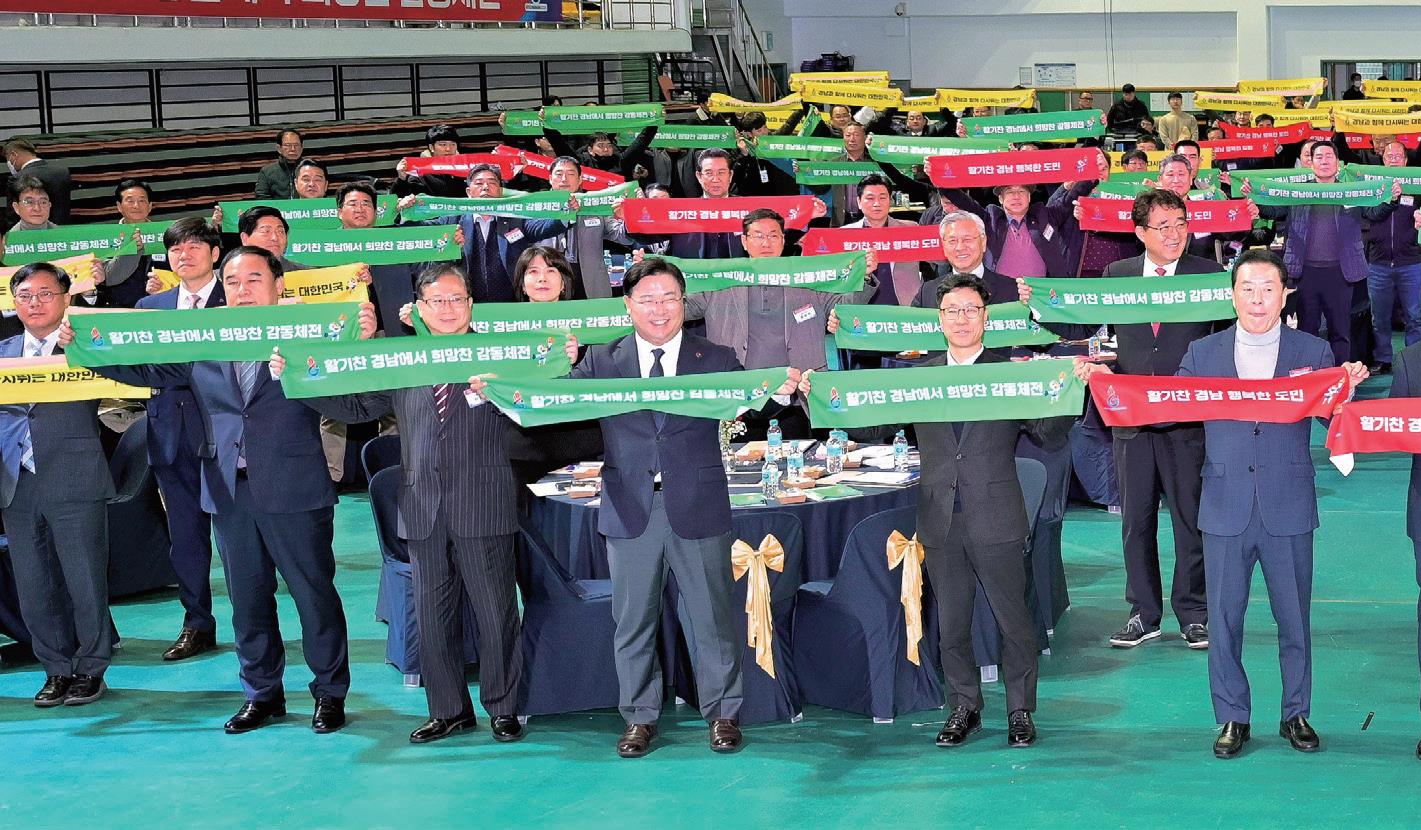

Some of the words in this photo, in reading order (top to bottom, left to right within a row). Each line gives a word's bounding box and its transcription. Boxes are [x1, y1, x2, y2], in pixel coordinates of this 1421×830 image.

[968, 166, 995, 175] 활기찬
[996, 165, 1014, 174] 경남
[1016, 163, 1042, 173] 행복한
[1043, 162, 1061, 172] 도민
[668, 210, 697, 220] 활기찬
[700, 210, 719, 219] 경남
[1194, 211, 1212, 220] 도민
[38, 241, 67, 252] 희망찬
[70, 239, 109, 250] 감동체전
[292, 243, 321, 253] 활기찬
[324, 242, 362, 252] 경남에서
[366, 241, 394, 251] 희망찬
[397, 240, 433, 251] 감동체전
[843, 241, 871, 251] 활기찬
[873, 240, 891, 250] 경남
[893, 239, 920, 249] 행복한
[922, 238, 940, 249] 도민
[299, 282, 344, 297] 대한민국
[1064, 293, 1098, 305] 활기찬
[1100, 292, 1148, 305] 경남에서
[1151, 291, 1186, 304] 희망찬
[866, 321, 898, 333] 활기찬
[108, 331, 153, 345] 활기찬
[157, 328, 215, 342] 경남에서
[220, 326, 262, 341] 희망찬
[266, 324, 322, 339] 감동체전
[324, 356, 367, 372] 활기찬
[371, 352, 427, 369] 경남에서
[432, 349, 473, 365] 희망찬
[477, 345, 531, 361] 감동체전
[846, 392, 886, 406] 활기찬
[890, 388, 944, 403] 경남에서
[948, 384, 987, 399] 희망찬
[991, 381, 1044, 396] 감동체전
[1147, 389, 1191, 403] 활기찬
[1194, 389, 1224, 401] 경남
[1228, 389, 1271, 401] 행복한
[1275, 389, 1304, 403] 도민
[1360, 416, 1404, 432] 활기찬
